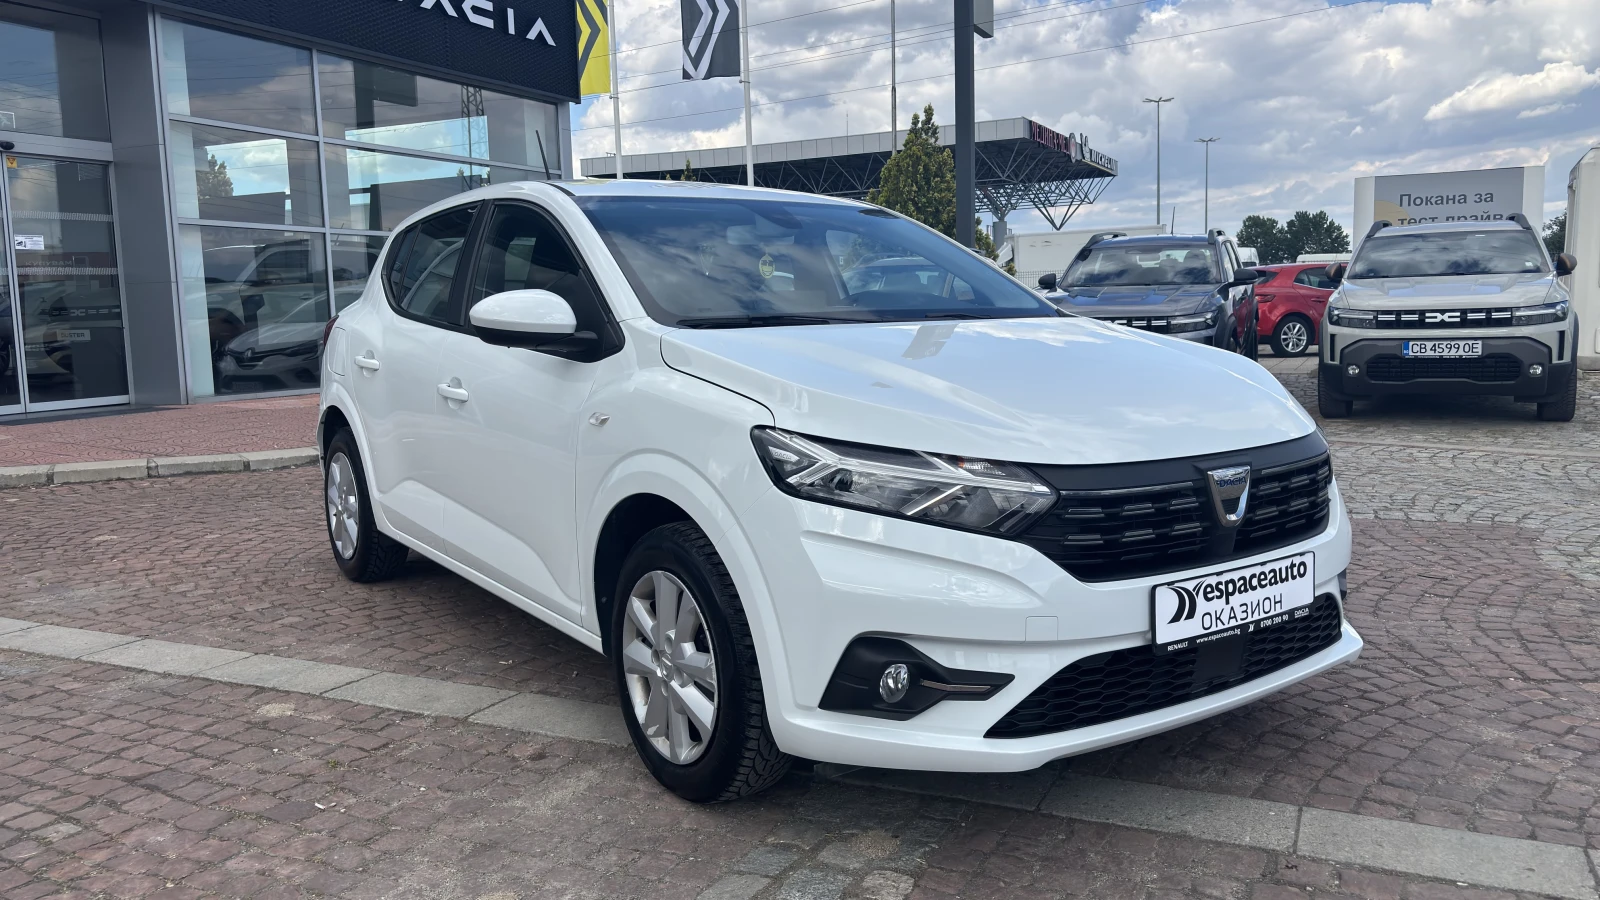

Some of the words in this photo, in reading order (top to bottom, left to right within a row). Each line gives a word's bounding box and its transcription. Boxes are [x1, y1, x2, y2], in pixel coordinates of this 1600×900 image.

[397, 0, 556, 46] CIA
[1399, 193, 1468, 207] Покана
[1473, 192, 1494, 204] за
[1411, 342, 1428, 354] CB
[1429, 342, 1461, 354] 4599
[1219, 476, 1247, 488] DACIA
[1202, 559, 1307, 605] espaceauto
[1201, 592, 1283, 631] ОКАЗИОН
[1167, 641, 1189, 651] RENAULT
[1196, 627, 1241, 644] www.espaceauto.bg
